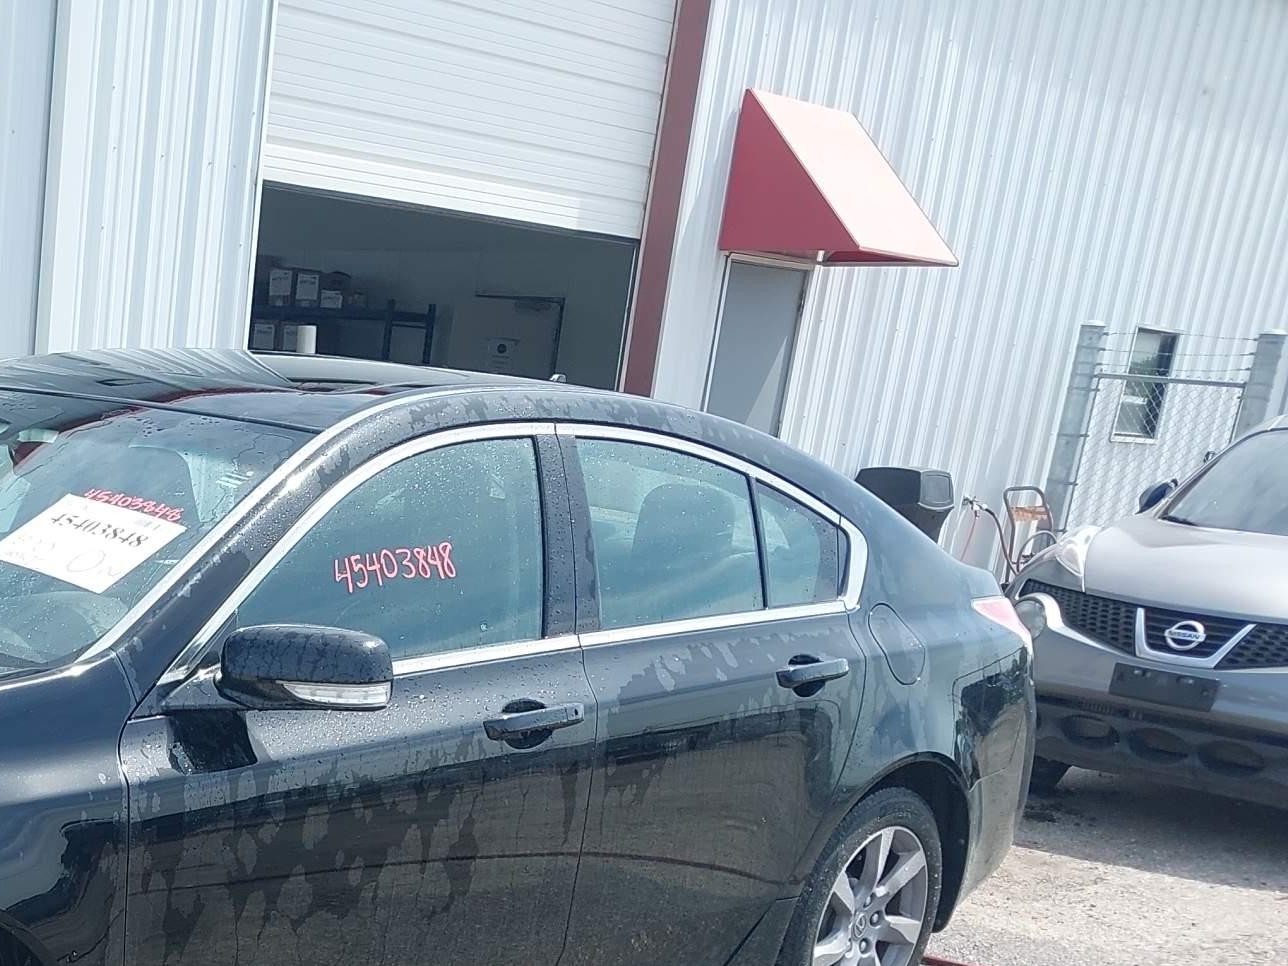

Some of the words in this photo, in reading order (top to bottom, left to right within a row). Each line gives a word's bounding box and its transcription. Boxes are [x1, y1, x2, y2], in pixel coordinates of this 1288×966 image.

[84, 488, 184, 521] 45403848
[50, 512, 150, 548] 45403848
[334, 541, 457, 594] 45403848
